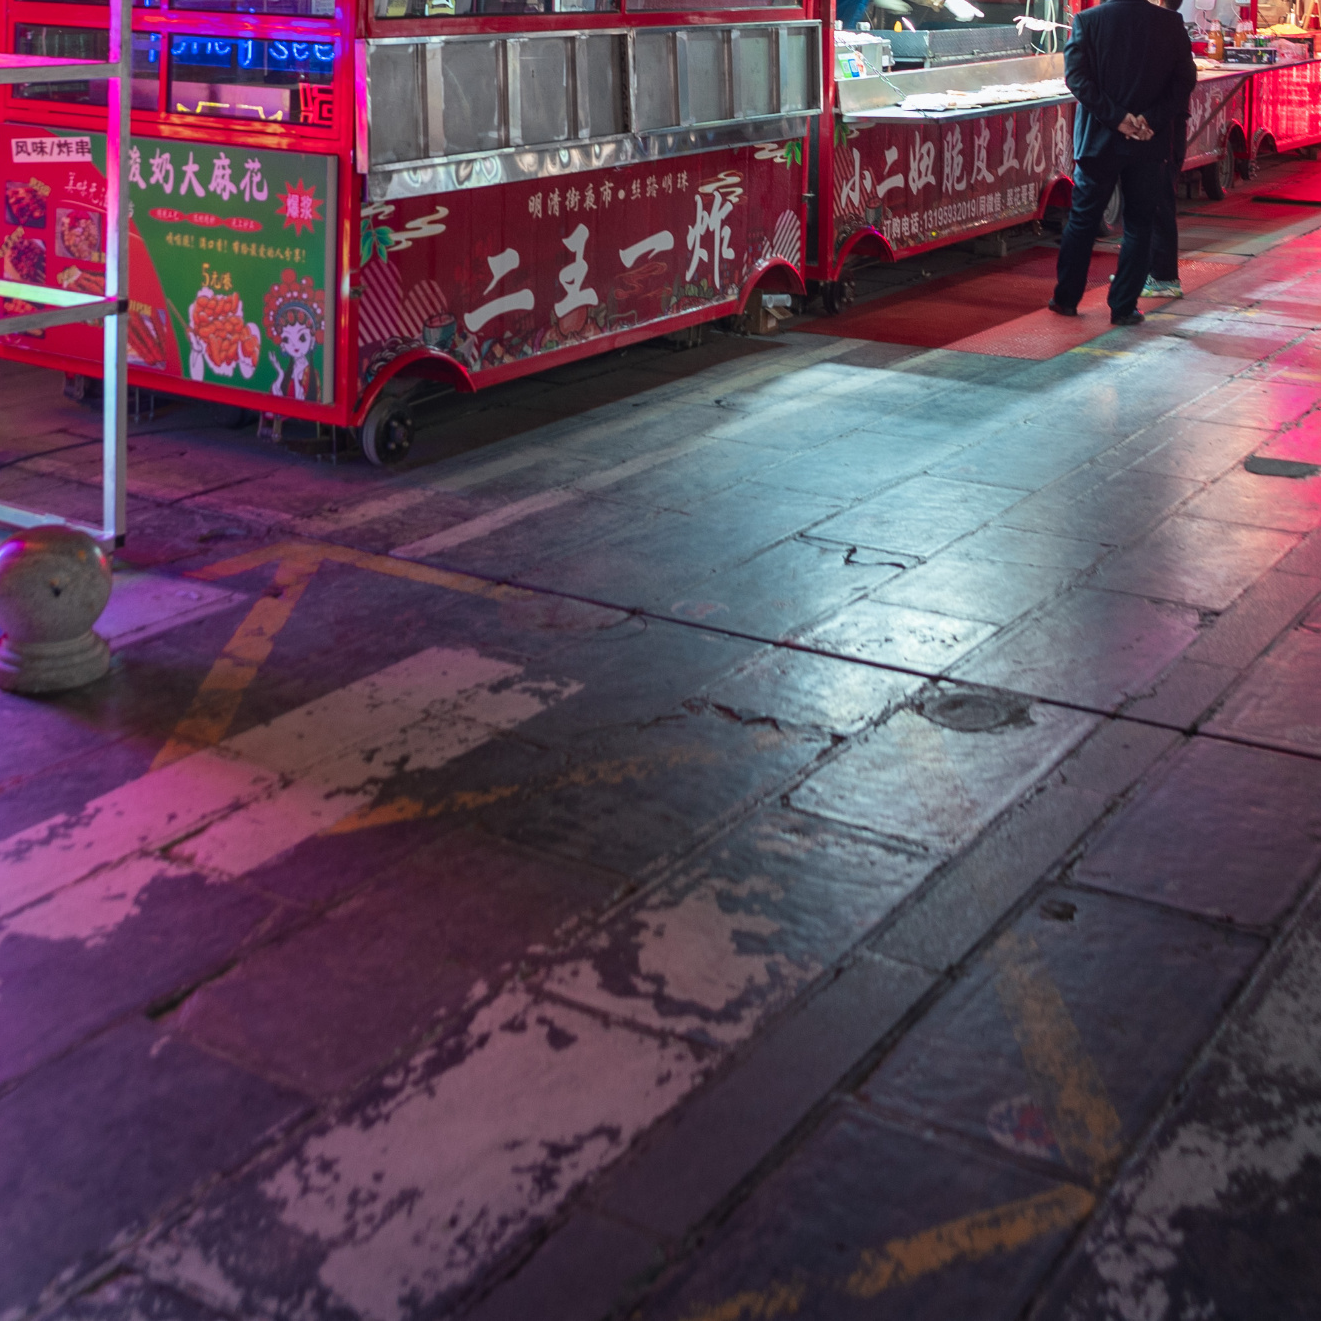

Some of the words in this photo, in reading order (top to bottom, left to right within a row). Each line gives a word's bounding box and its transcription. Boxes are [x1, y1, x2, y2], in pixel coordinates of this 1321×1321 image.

[14, 139, 91, 157] 风味/炸串
[286, 193, 313, 219] 爆浆
[463, 192, 735, 333] 二王一炸
